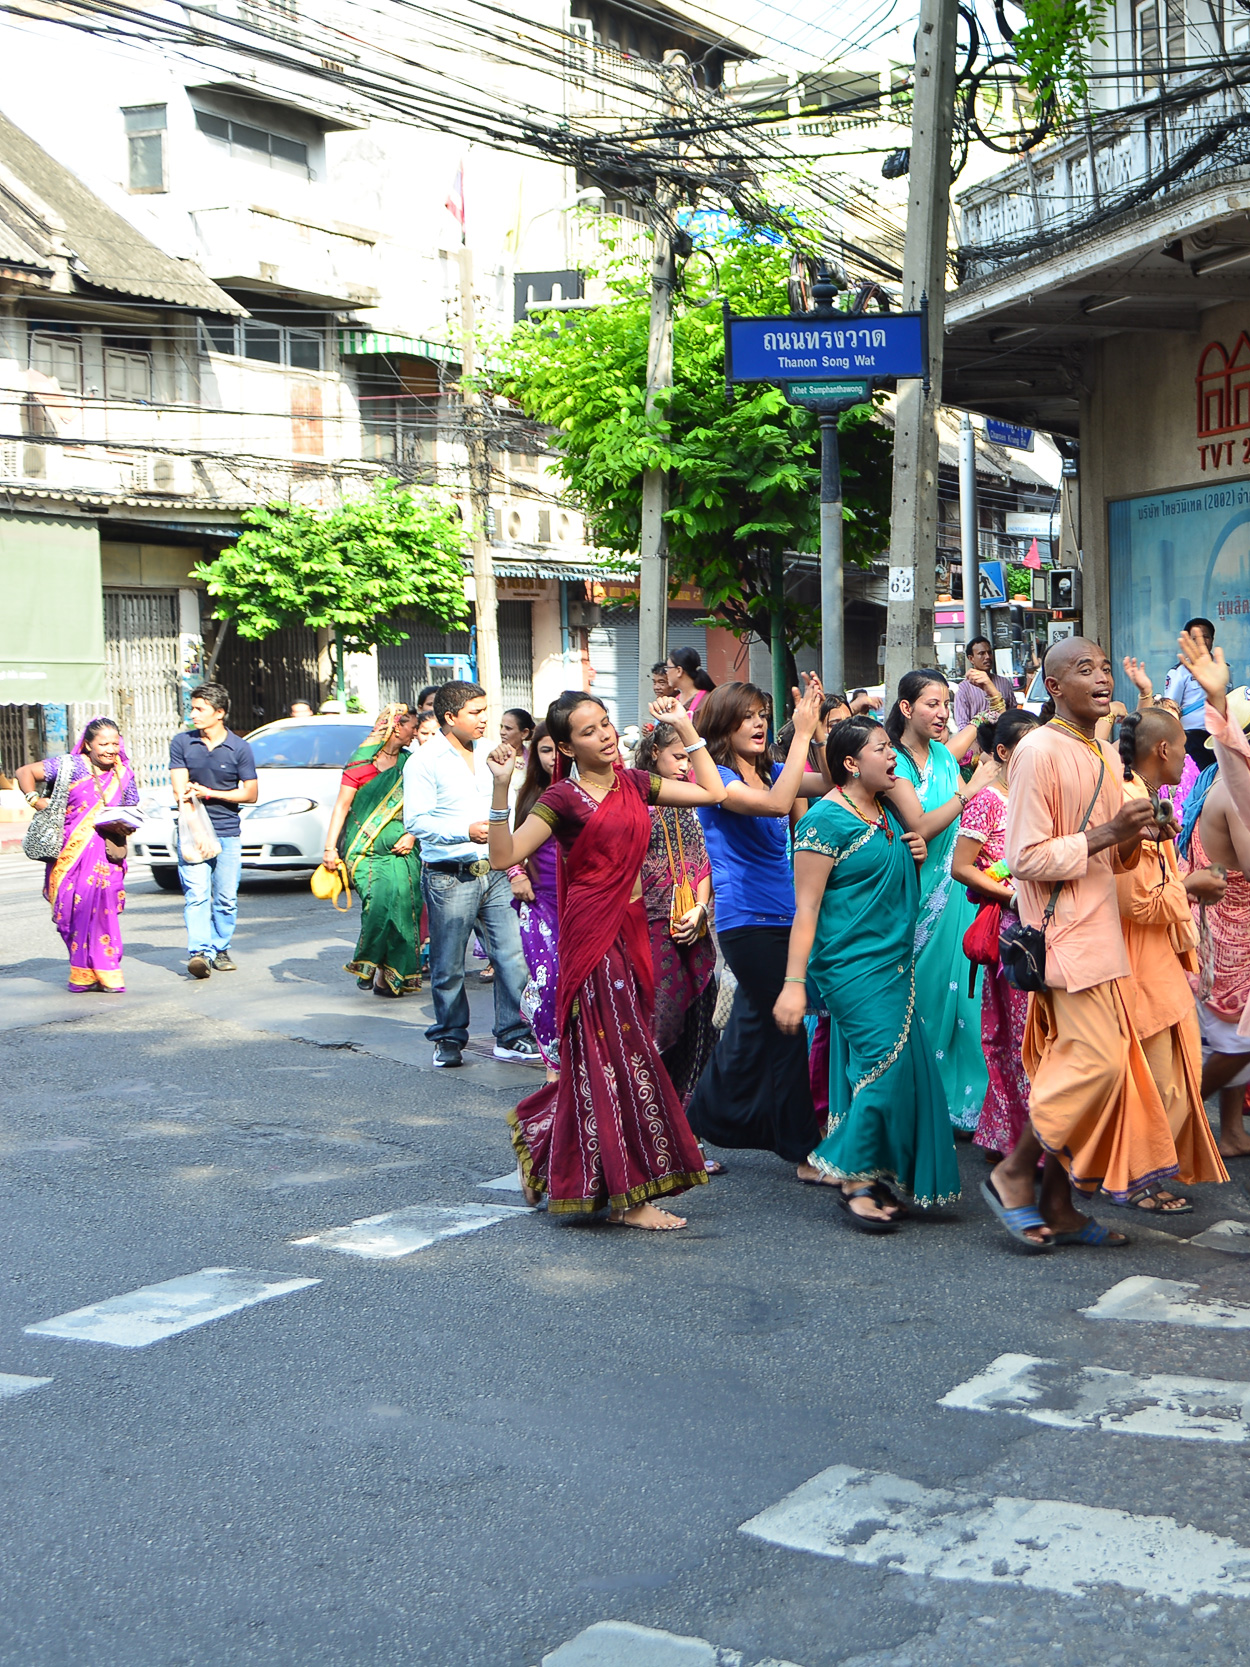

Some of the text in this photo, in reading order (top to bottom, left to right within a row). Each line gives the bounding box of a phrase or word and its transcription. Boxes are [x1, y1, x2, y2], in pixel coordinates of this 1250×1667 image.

[763, 329, 886, 351] ถนนทรงวาด
[778, 354, 875, 369] Thanon Song Wat
[792, 385, 863, 395] Khet Samphanthawong
[1197, 440, 1235, 471] TVT
[1138, 501, 1160, 520] บริษัท
[1204, 491, 1235, 511] (2002)
[890, 578, 911, 594] 62
[951, 612, 959, 623] 1
